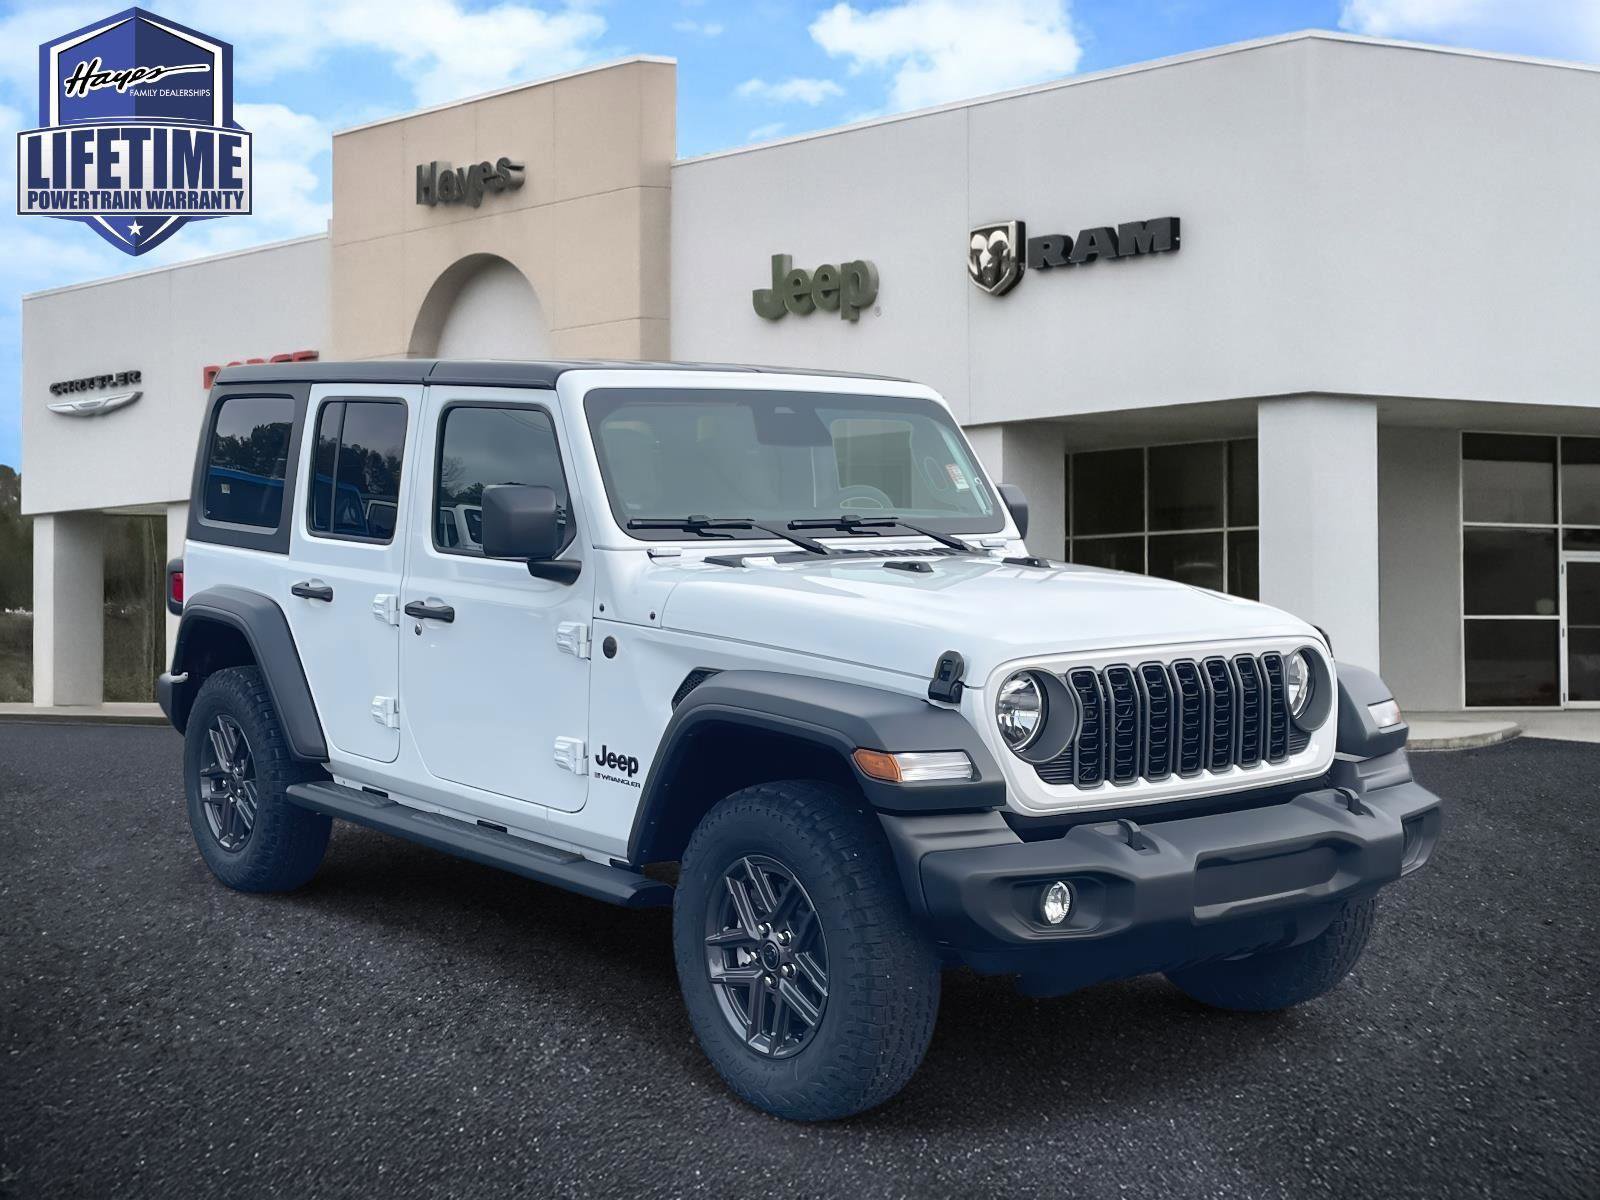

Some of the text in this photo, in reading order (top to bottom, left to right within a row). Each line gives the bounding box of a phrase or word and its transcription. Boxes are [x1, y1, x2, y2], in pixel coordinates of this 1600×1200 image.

[416, 157, 525, 208] Hayes
[1027, 216, 1181, 270] RAM
[752, 253, 880, 323] Jeep
[595, 744, 639, 778] Jeep
